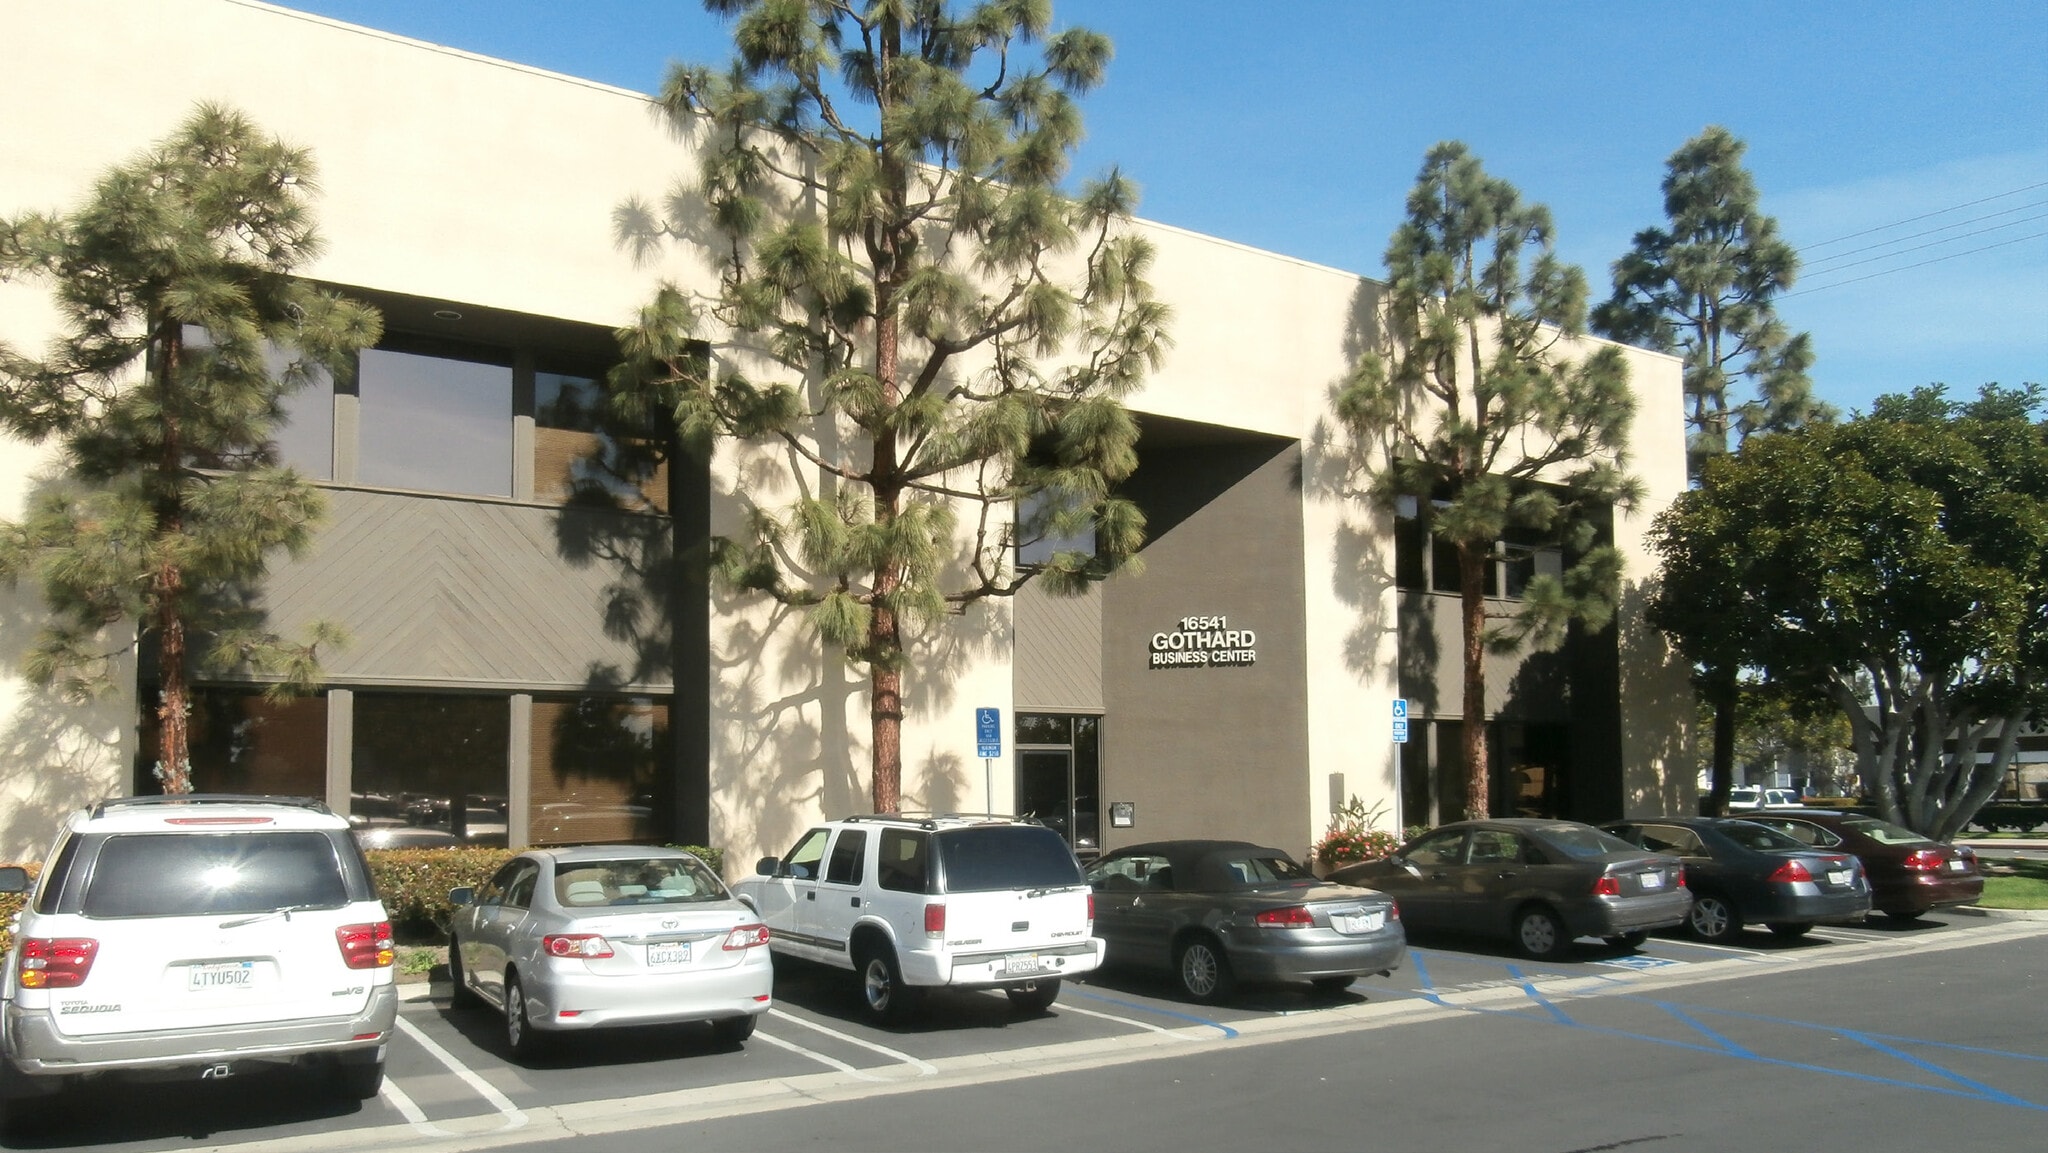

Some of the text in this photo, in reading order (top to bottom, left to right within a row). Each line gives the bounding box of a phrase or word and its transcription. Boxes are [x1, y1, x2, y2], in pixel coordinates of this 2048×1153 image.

[1181, 615, 1227, 631] 16541
[1152, 630, 1257, 650] GOTHARD
[1152, 649, 1257, 665] BUSINESS CENTER
[193, 970, 250, 986] 4TYU502
